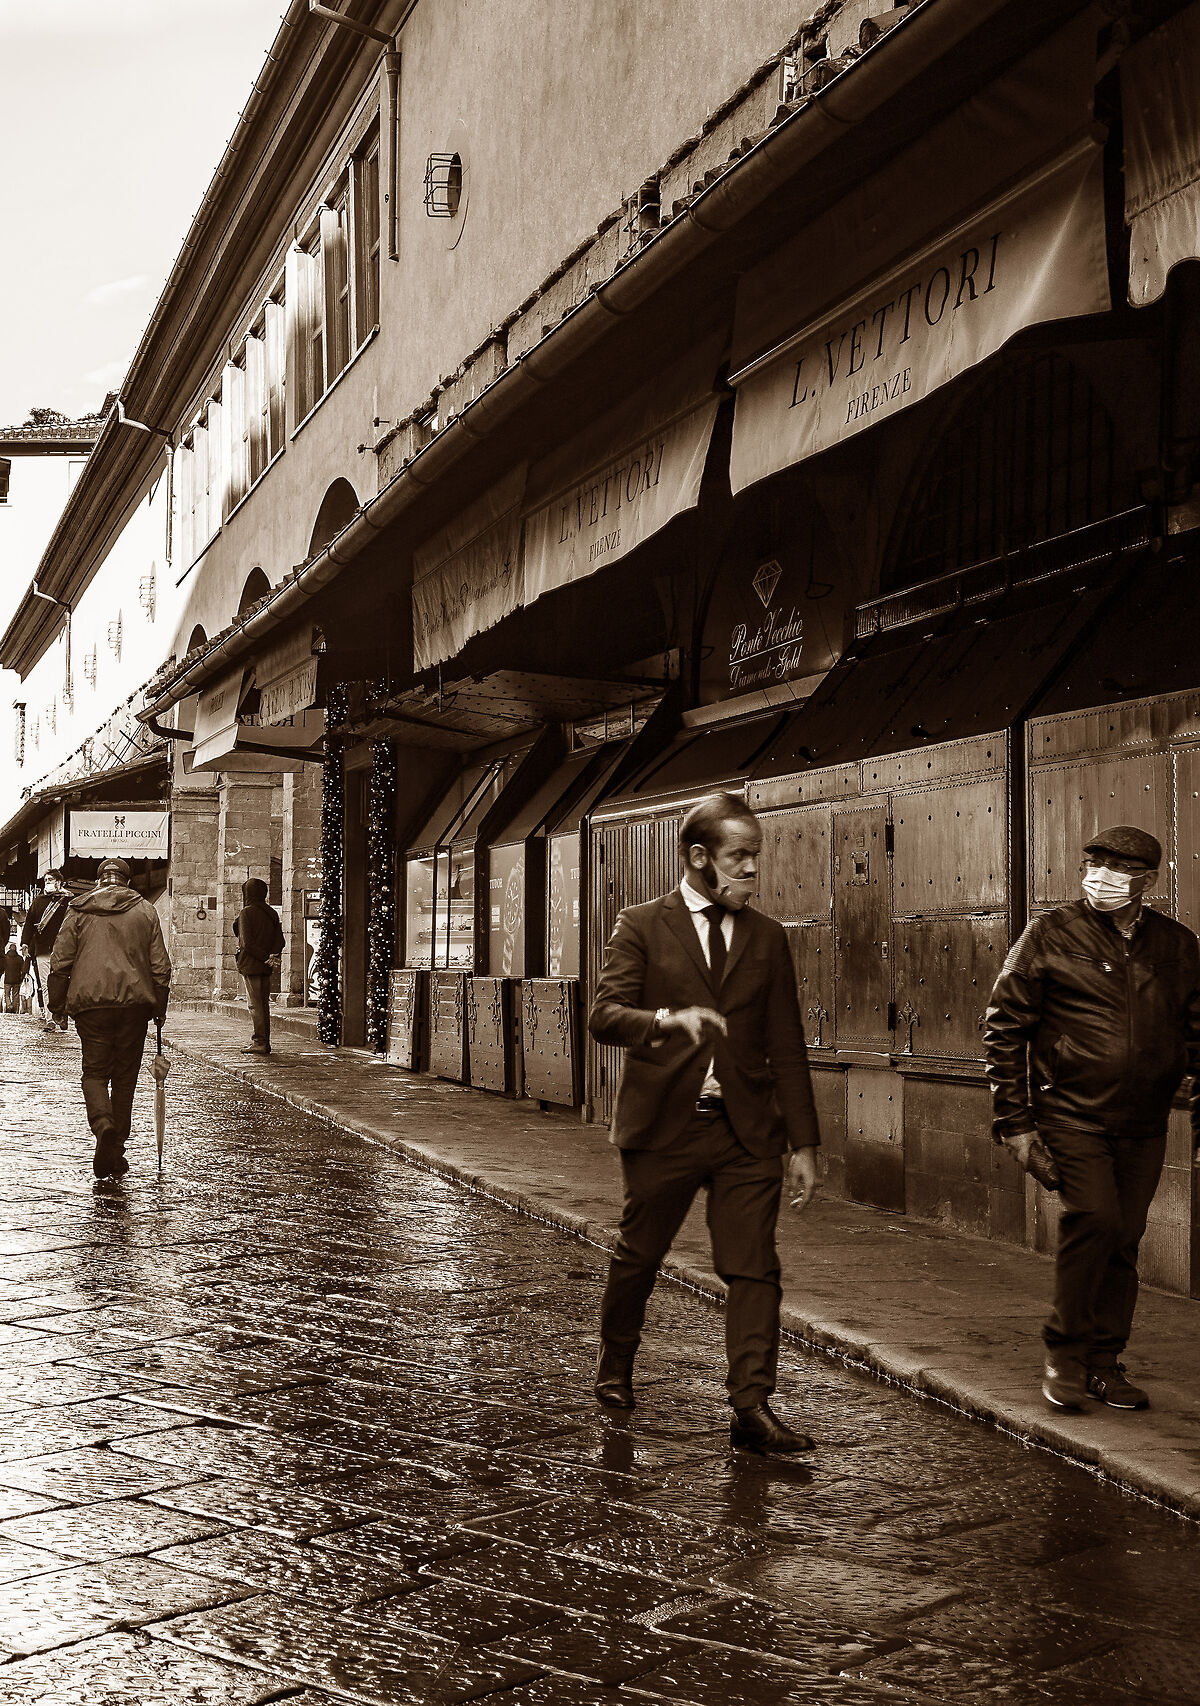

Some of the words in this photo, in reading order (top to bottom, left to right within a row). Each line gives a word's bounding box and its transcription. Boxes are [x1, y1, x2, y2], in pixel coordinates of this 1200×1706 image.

[845, 367, 912, 424] FIRENZE
[729, 623, 763, 661] Ponte
[763, 607, 803, 648] Vecchio
[78, 829, 123, 838] FRATELLI
[125, 830, 162, 839] PICCINI
